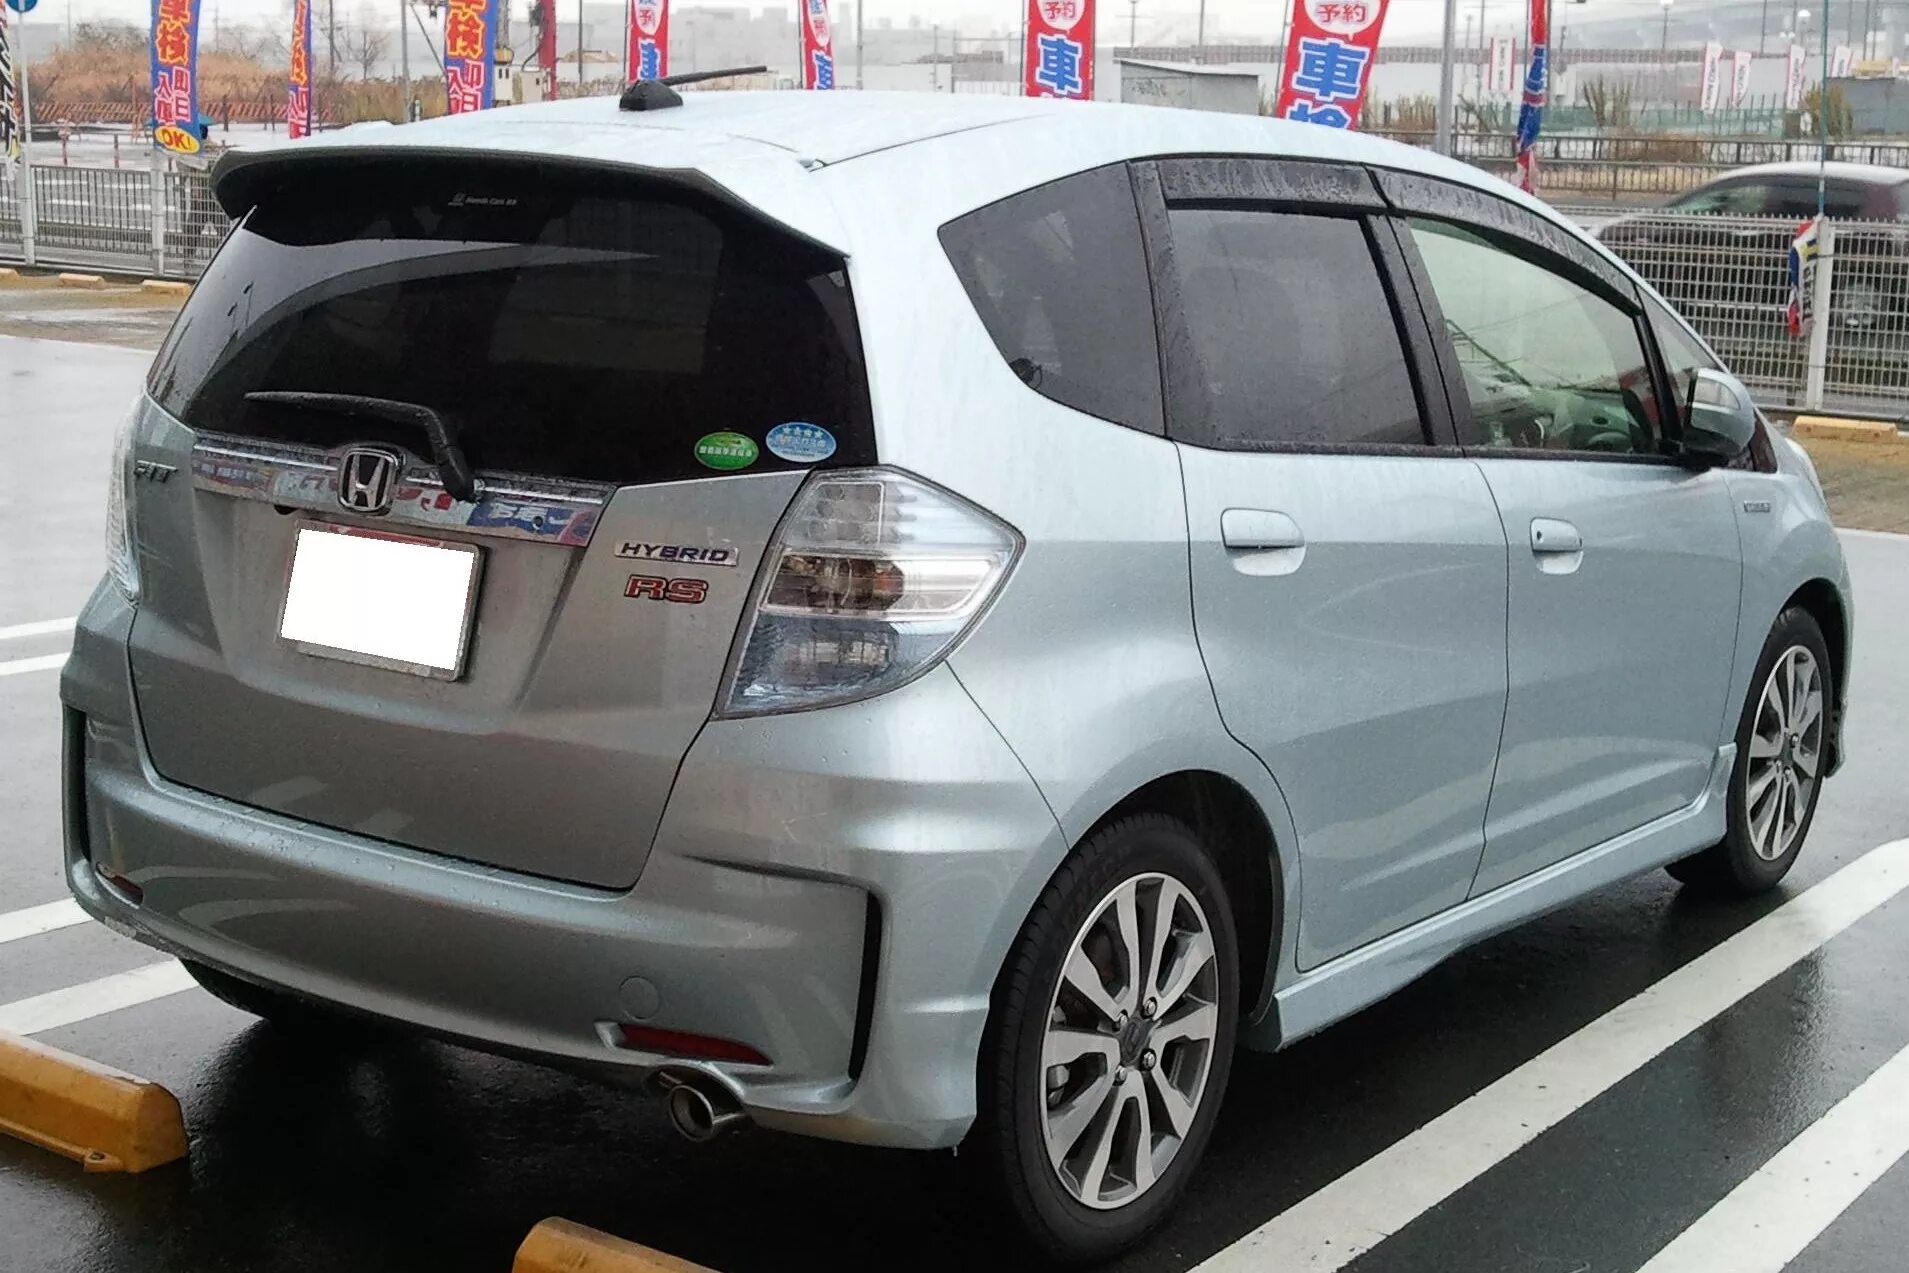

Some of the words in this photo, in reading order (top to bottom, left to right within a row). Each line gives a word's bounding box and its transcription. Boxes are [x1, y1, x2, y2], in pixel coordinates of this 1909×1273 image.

[1045, 1, 1076, 20] 予約
[1318, 2, 1367, 23] 予約
[447, 0, 487, 59] 検
[1037, 34, 1082, 94] 車
[161, 128, 192, 151] OK!
[621, 542, 730, 562] HYBRID
[624, 574, 709, 604] RS
